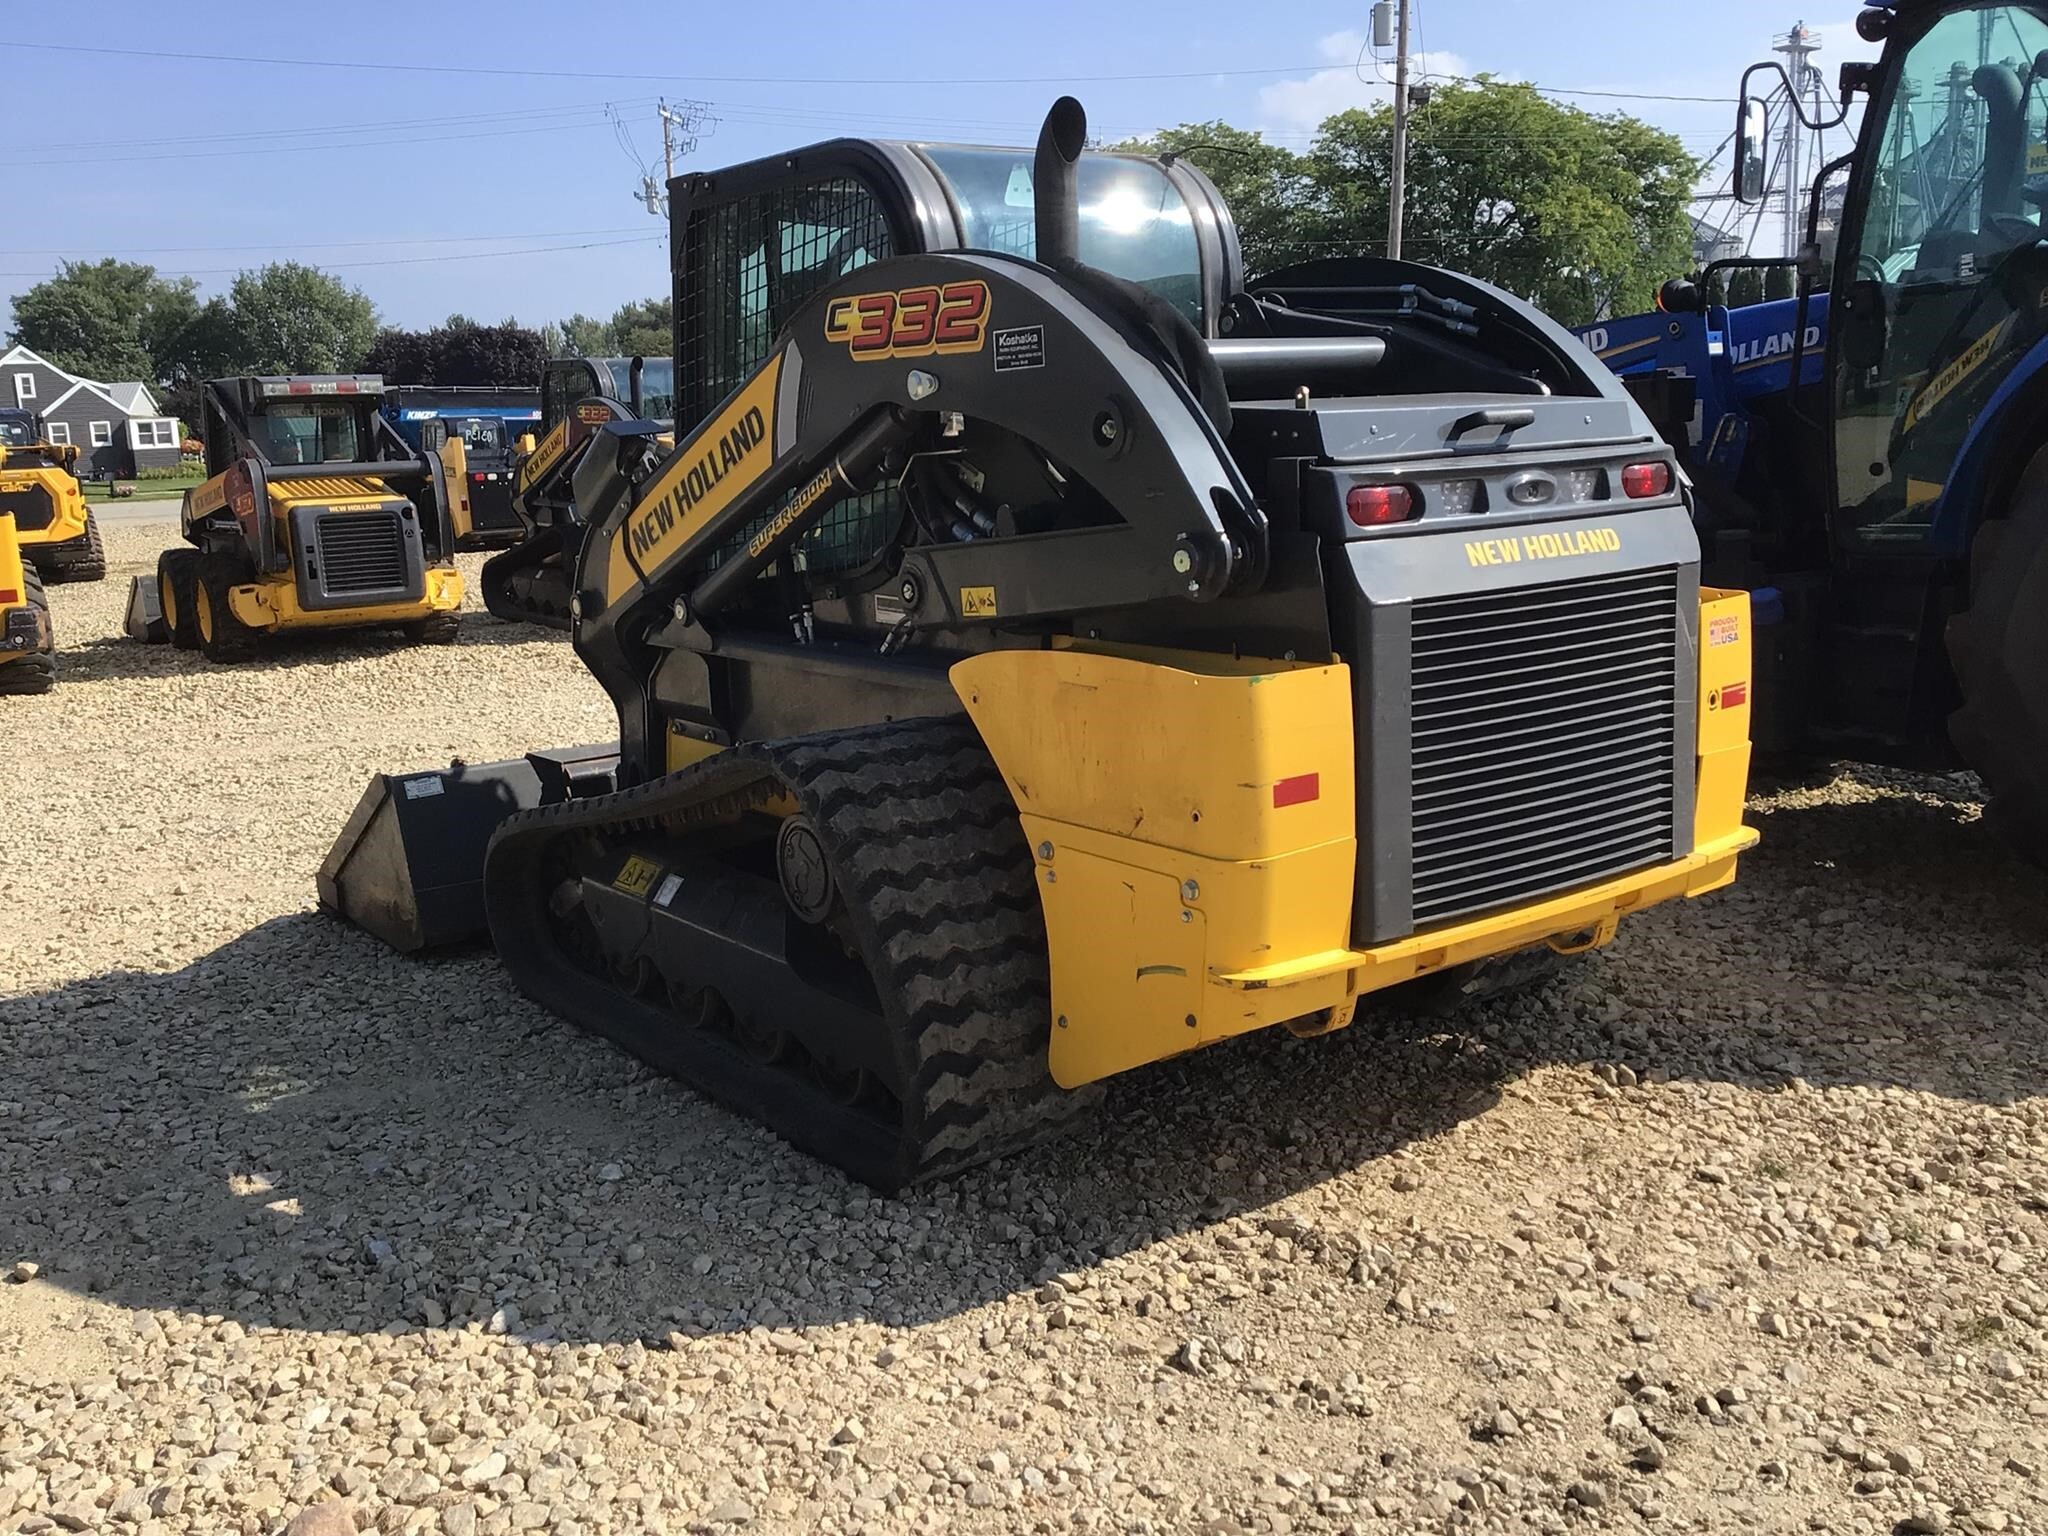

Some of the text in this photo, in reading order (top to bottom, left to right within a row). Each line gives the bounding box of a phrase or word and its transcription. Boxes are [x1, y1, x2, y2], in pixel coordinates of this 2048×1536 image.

[406, 410, 438, 419] KINZE
[631, 405, 765, 559] NEW HOLLAND
[328, 503, 382, 513] NEW HOLLAND
[749, 467, 832, 557] SUPER BOOM
[1465, 528, 1621, 567] NEW HOLLAND
[1721, 632, 1739, 644] USA
